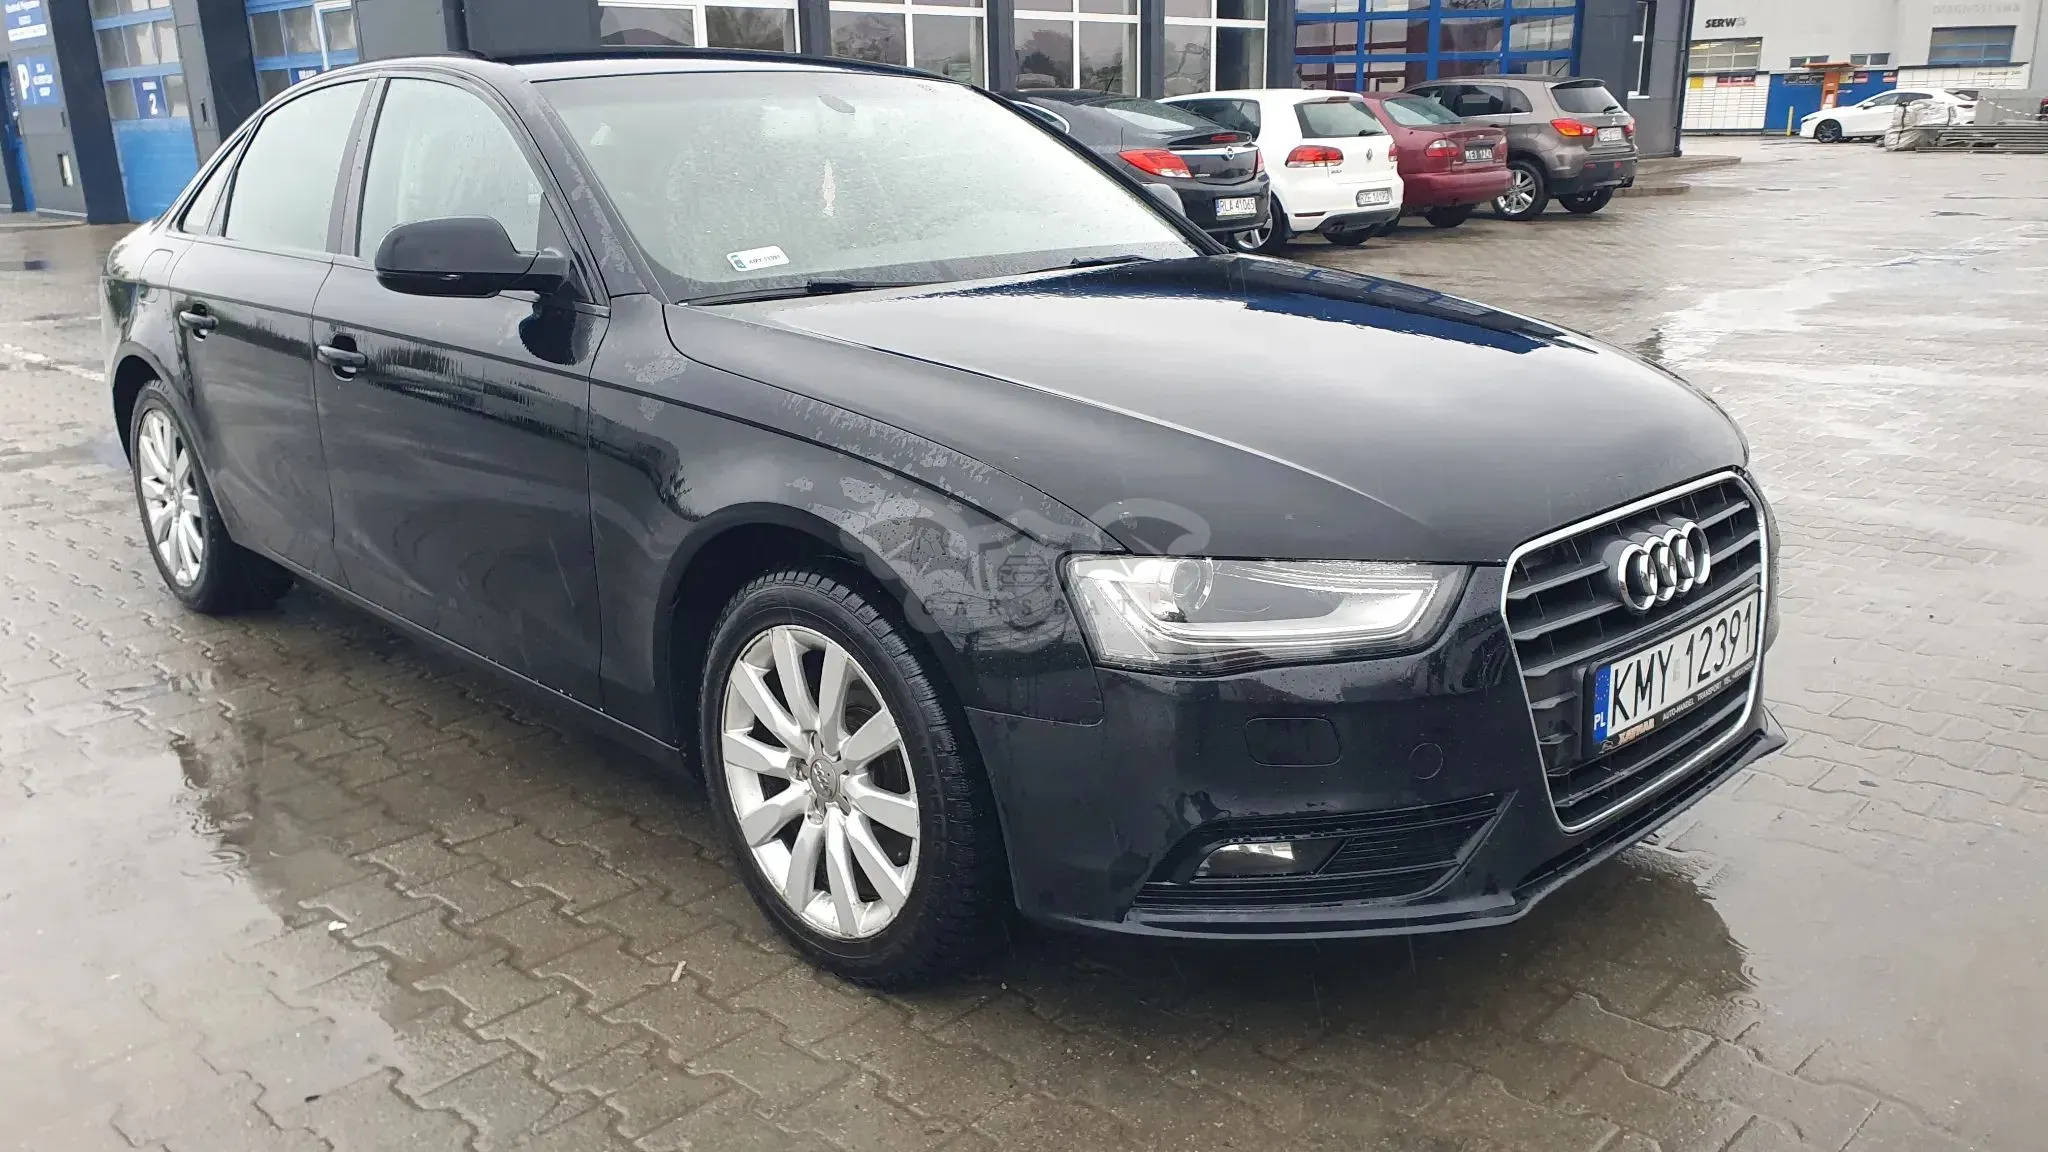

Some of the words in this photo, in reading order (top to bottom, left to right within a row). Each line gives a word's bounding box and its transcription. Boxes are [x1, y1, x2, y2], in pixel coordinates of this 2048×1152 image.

[16, 63, 30, 100] P
[148, 93, 158, 115] 2
[1611, 644, 1674, 728] KMY
[1685, 600, 1752, 691] 12391
[1593, 712, 1606, 730] PL
